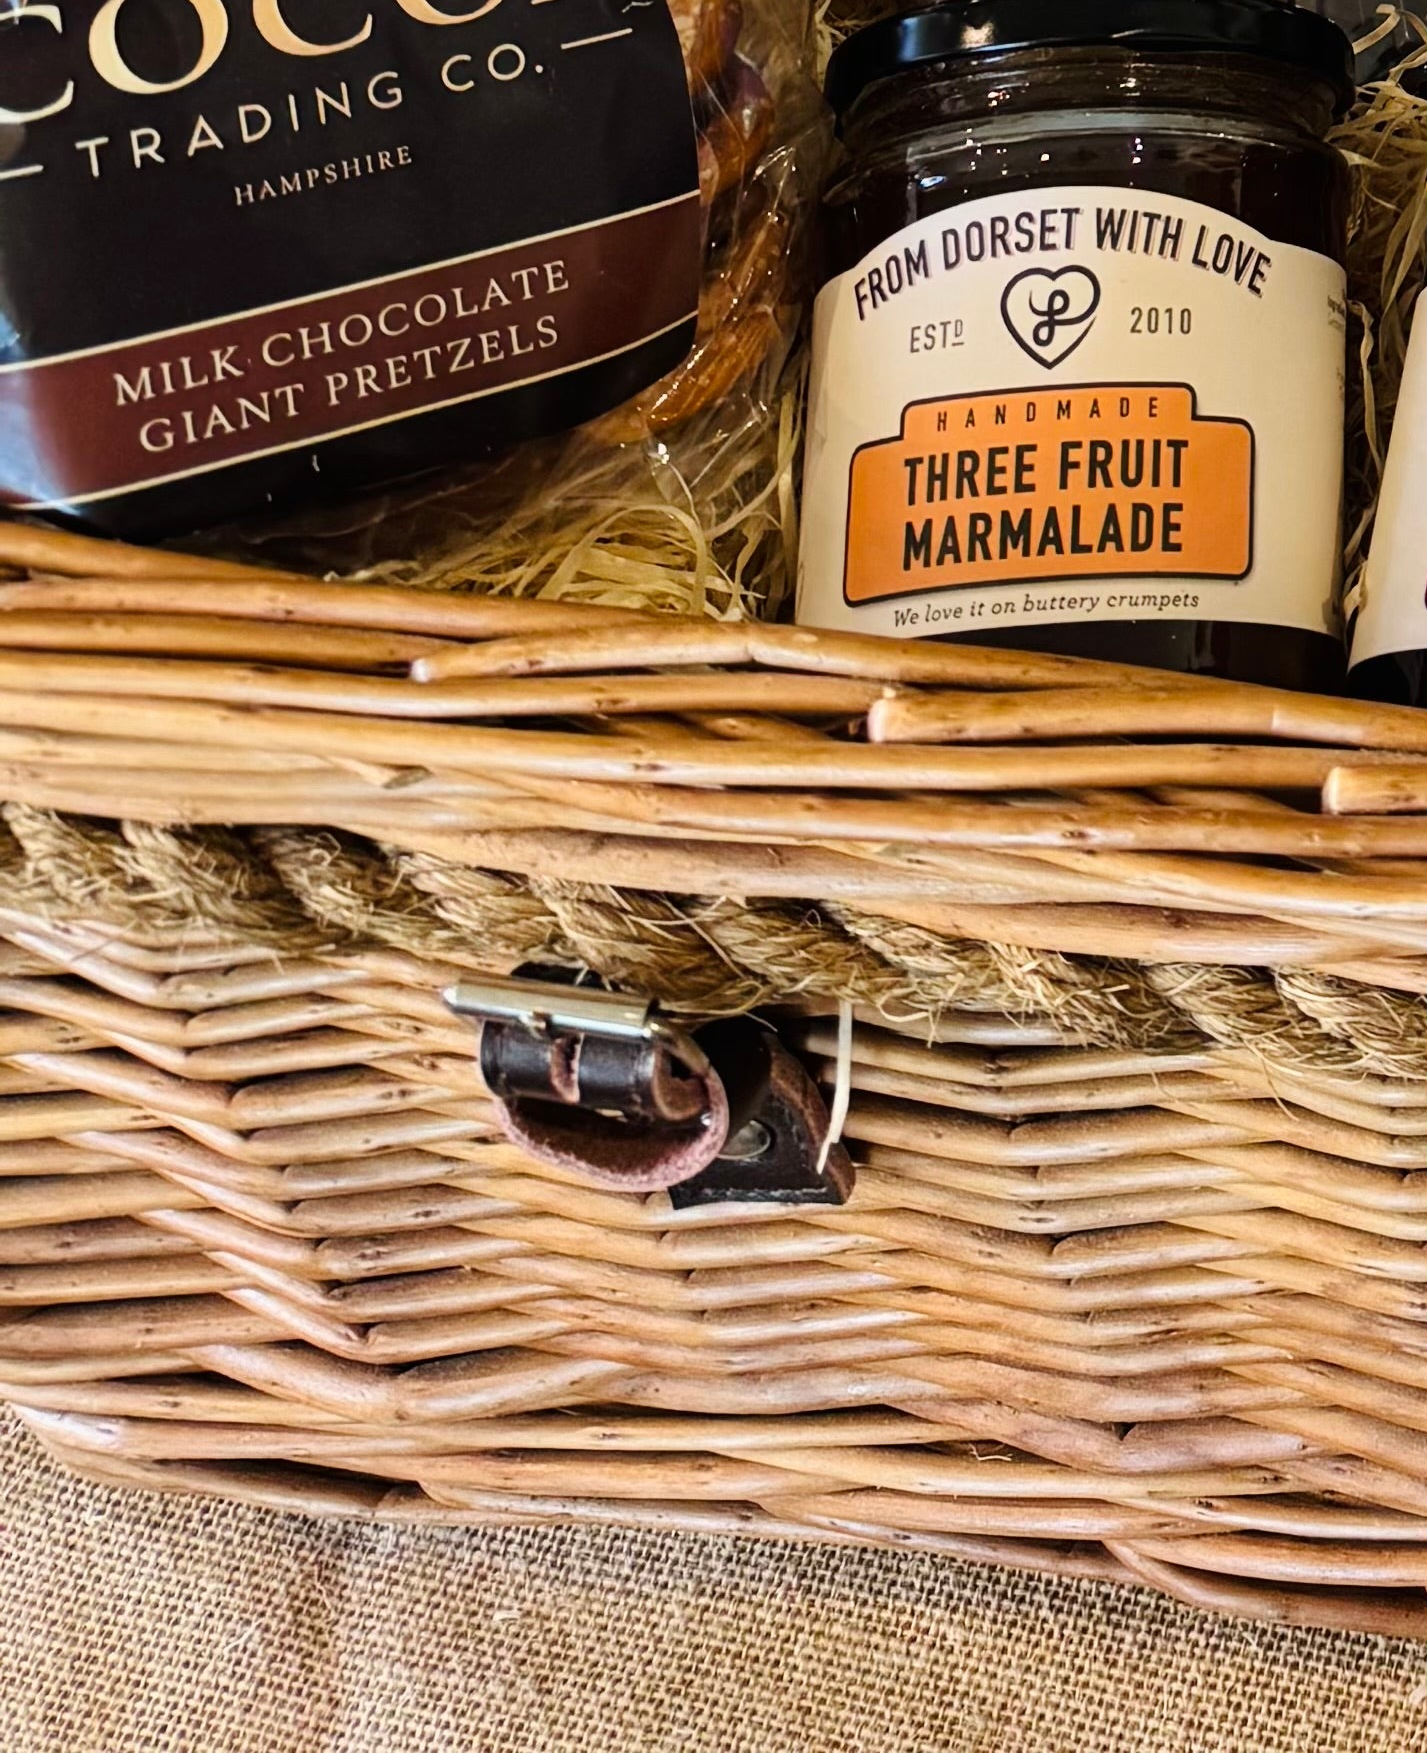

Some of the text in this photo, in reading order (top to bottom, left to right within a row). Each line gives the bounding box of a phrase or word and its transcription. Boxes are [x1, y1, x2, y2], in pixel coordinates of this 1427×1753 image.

[75, 43, 544, 179] TRADING CO.
[233, 145, 413, 206] HAMPSHIRE
[113, 259, 570, 405] MILK CHOCOLATE
[138, 315, 561, 453] GIANT PRETZELS
[905, 439, 1190, 506] THREE FRUIT
[903, 503, 1184, 571] MARMALADE
[893, 591, 1200, 628] We love it on buttery crumpets
